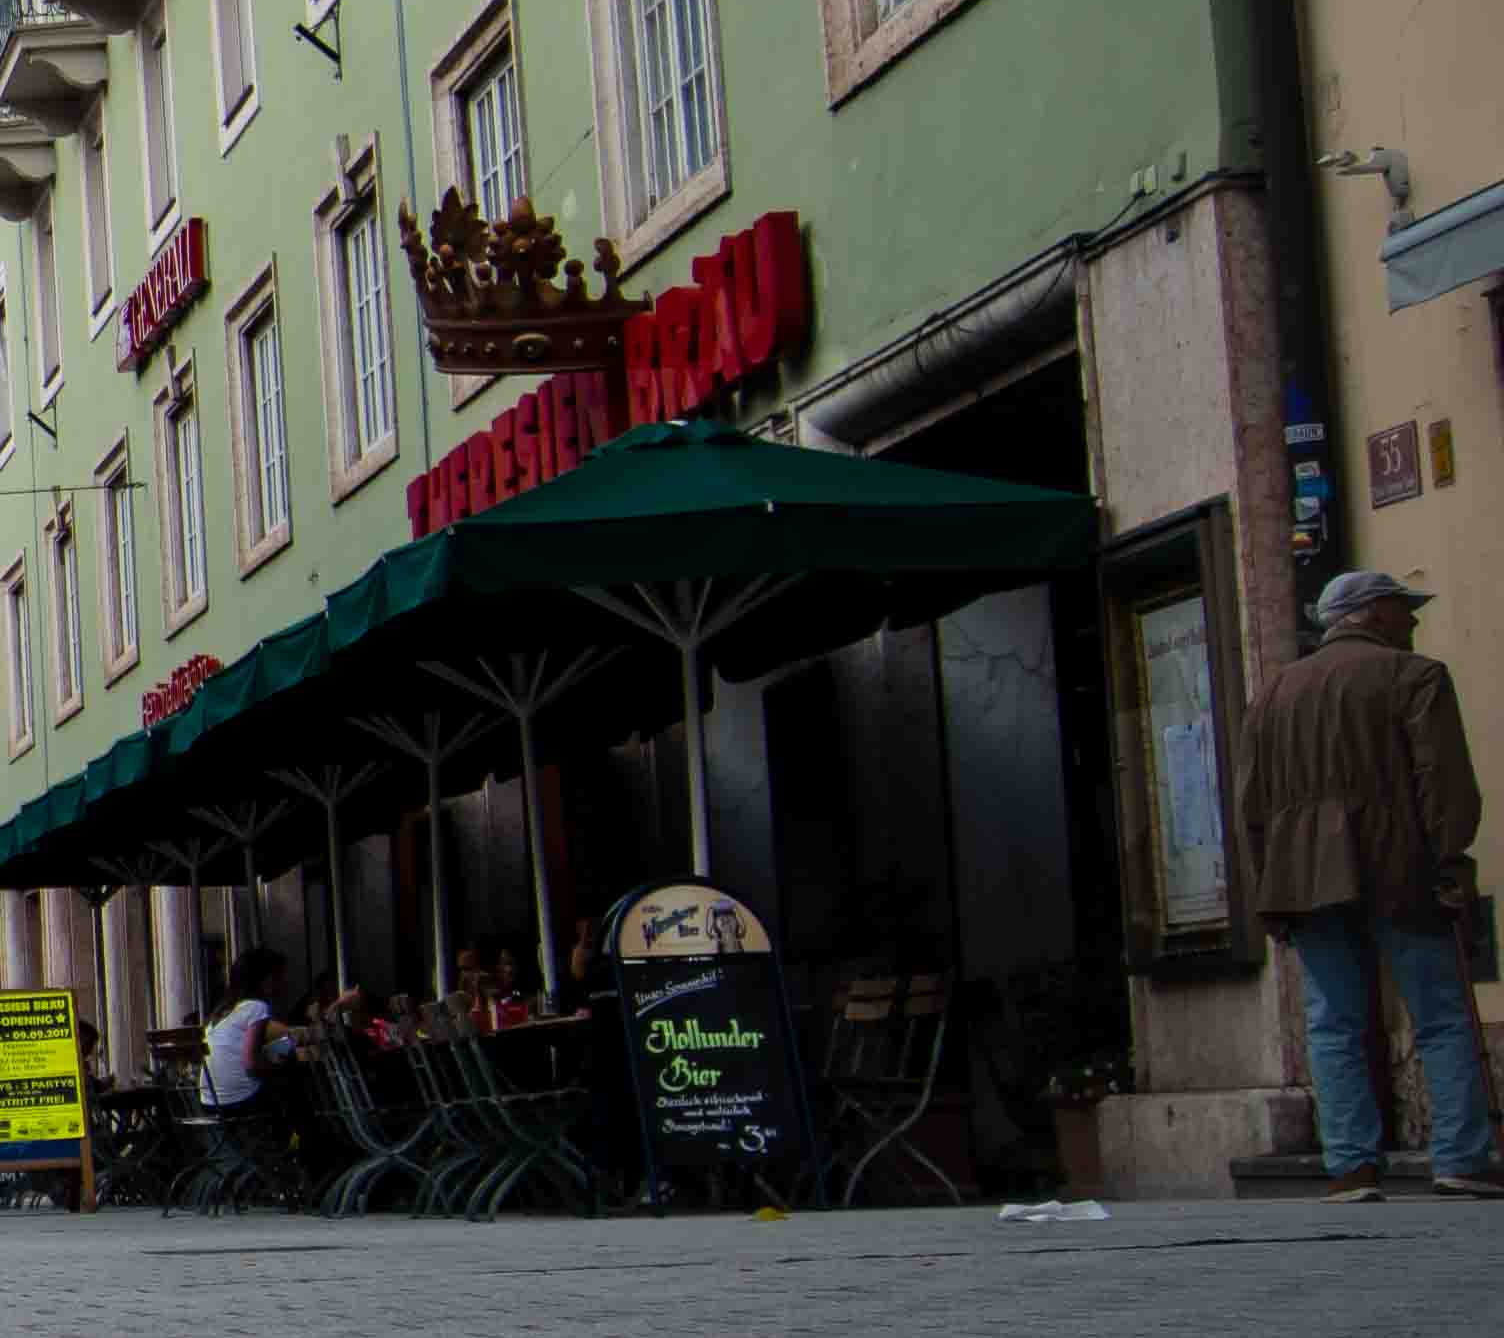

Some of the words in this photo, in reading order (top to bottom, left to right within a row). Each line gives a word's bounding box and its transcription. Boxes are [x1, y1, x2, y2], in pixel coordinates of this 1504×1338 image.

[407, 373, 613, 539] THERESIEN
[1378, 433, 1402, 476] 55
[12, 1028, 70, 1040] 09.09.2017
[645, 1017, 766, 1054] Hollunder
[658, 1054, 722, 1092] Bier
